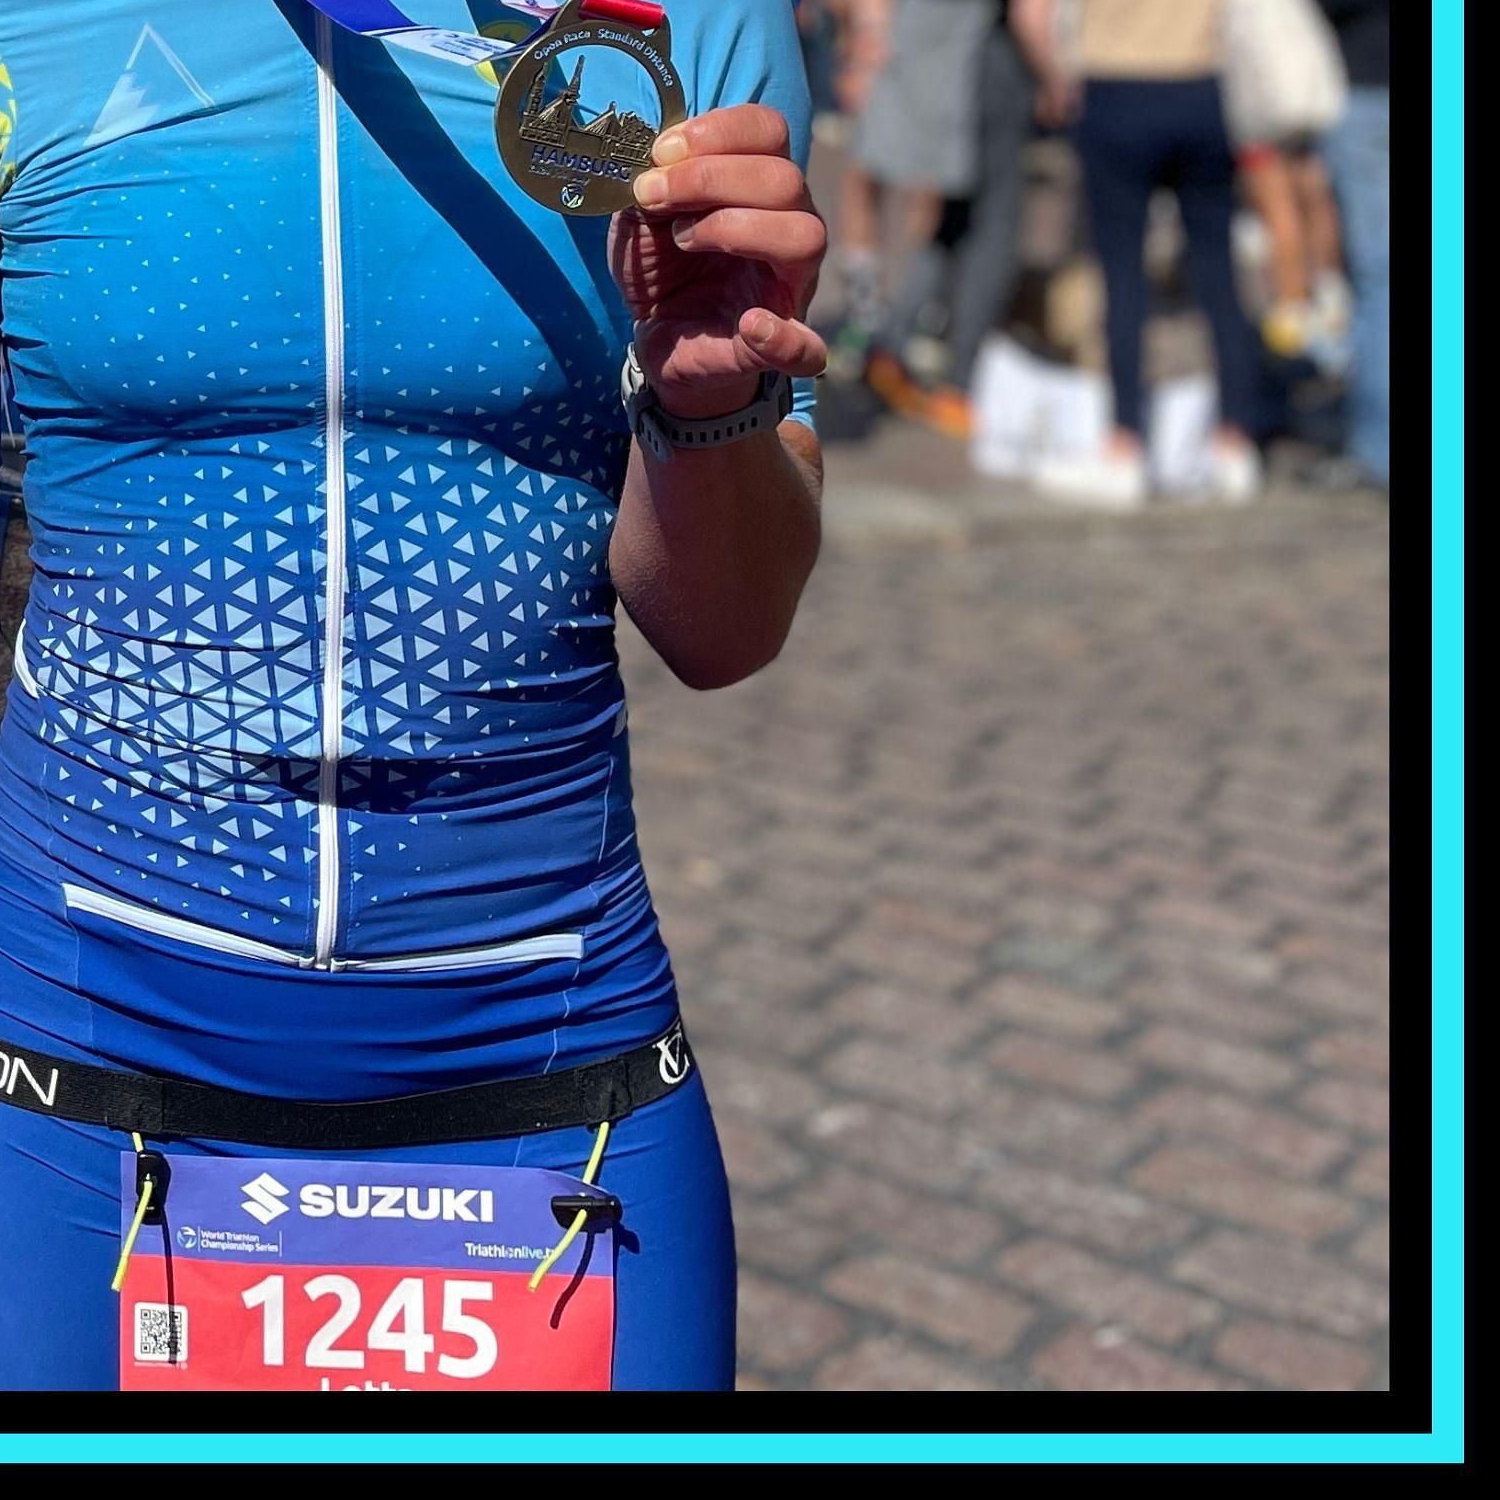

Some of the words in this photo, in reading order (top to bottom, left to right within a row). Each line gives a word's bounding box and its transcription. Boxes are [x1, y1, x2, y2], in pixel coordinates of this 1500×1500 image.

[597, 28, 647, 51] Standard
[530, 144, 633, 183] HAMBURG
[299, 1183, 495, 1224] SUZUKI
[200, 1230, 225, 1240] World
[225, 1231, 260, 1243] Triathlon
[200, 1240, 255, 1253] Championship
[255, 1243, 279, 1253] Series
[240, 1273, 499, 1380] 1245
